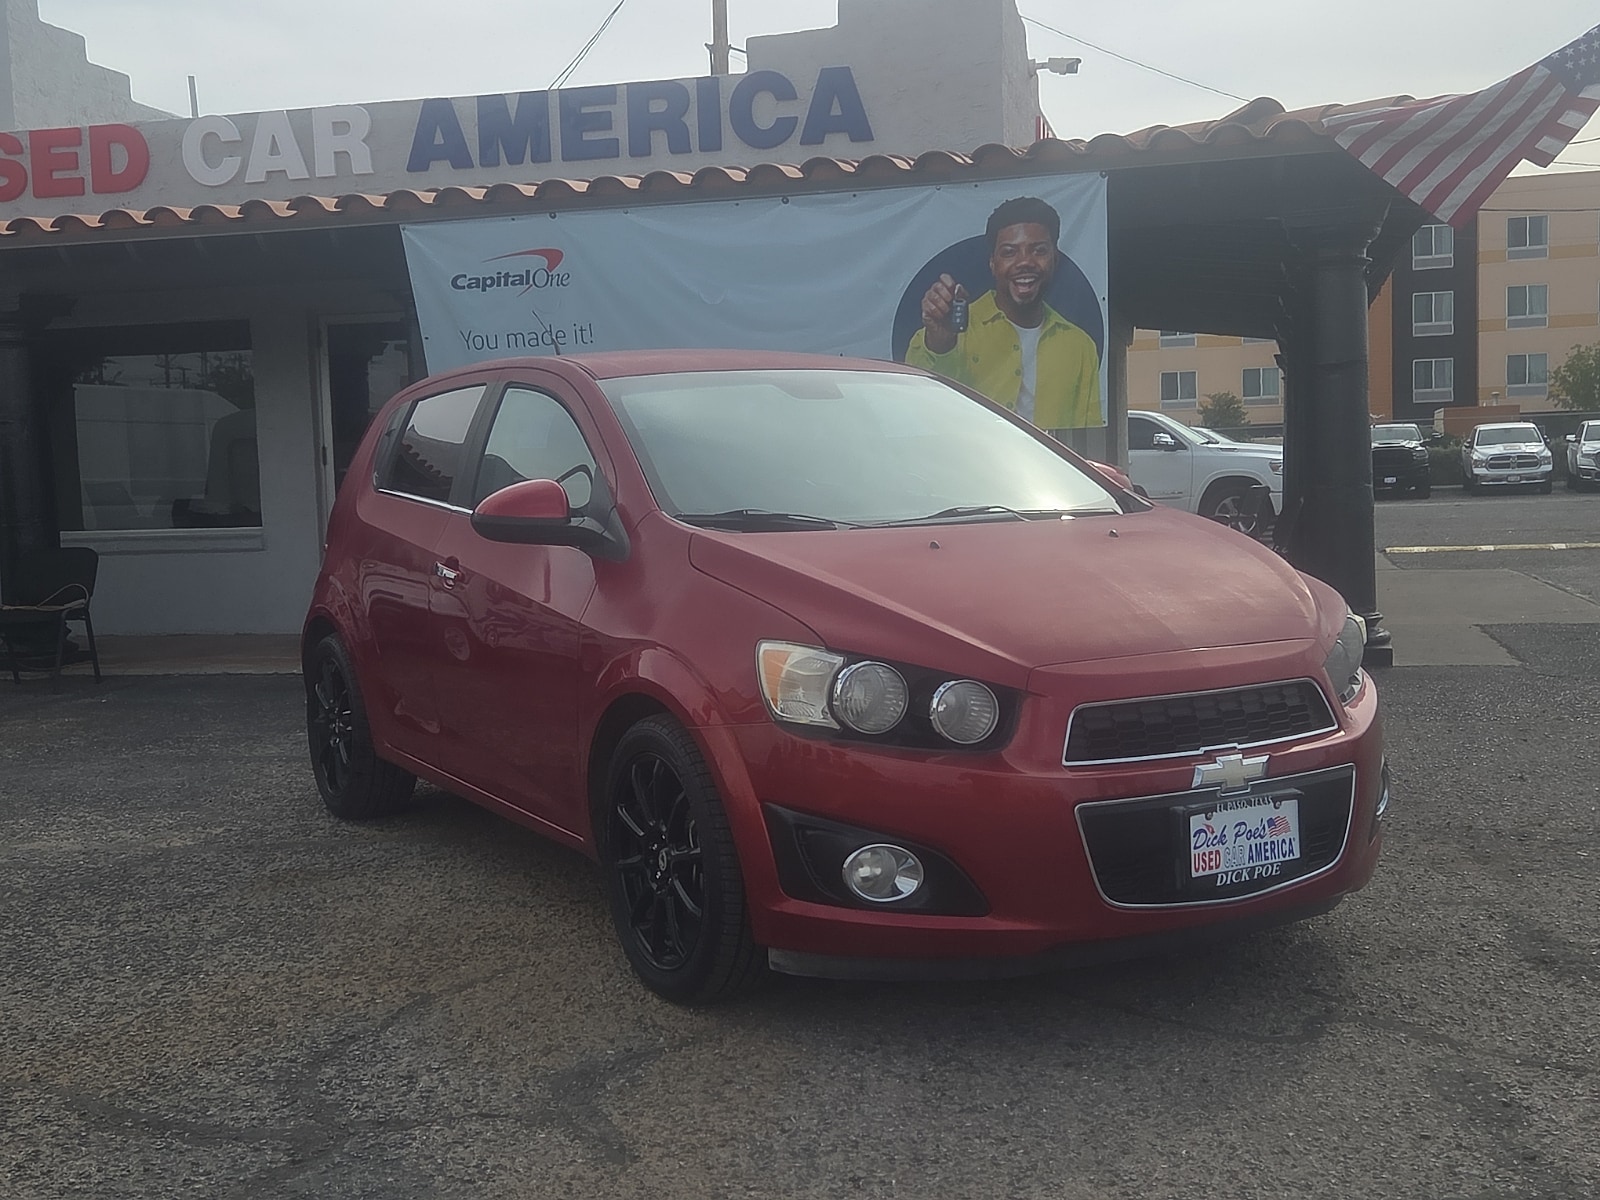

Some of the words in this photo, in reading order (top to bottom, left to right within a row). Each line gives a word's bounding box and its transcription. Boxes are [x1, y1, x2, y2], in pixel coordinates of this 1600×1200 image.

[182, 105, 374, 186] CAR
[406, 66, 875, 172] AMERICA
[460, 329, 498, 351] You
[506, 323, 567, 349] made
[573, 322, 594, 345] it!
[1193, 824, 1228, 850] Dick
[1233, 817, 1267, 844] Poe's
[1193, 849, 1222, 873] USED
[1224, 844, 1246, 868] CAR
[1247, 837, 1296, 864] AMERICA
[1216, 867, 1250, 886] DICK
[1254, 862, 1281, 879] POE
